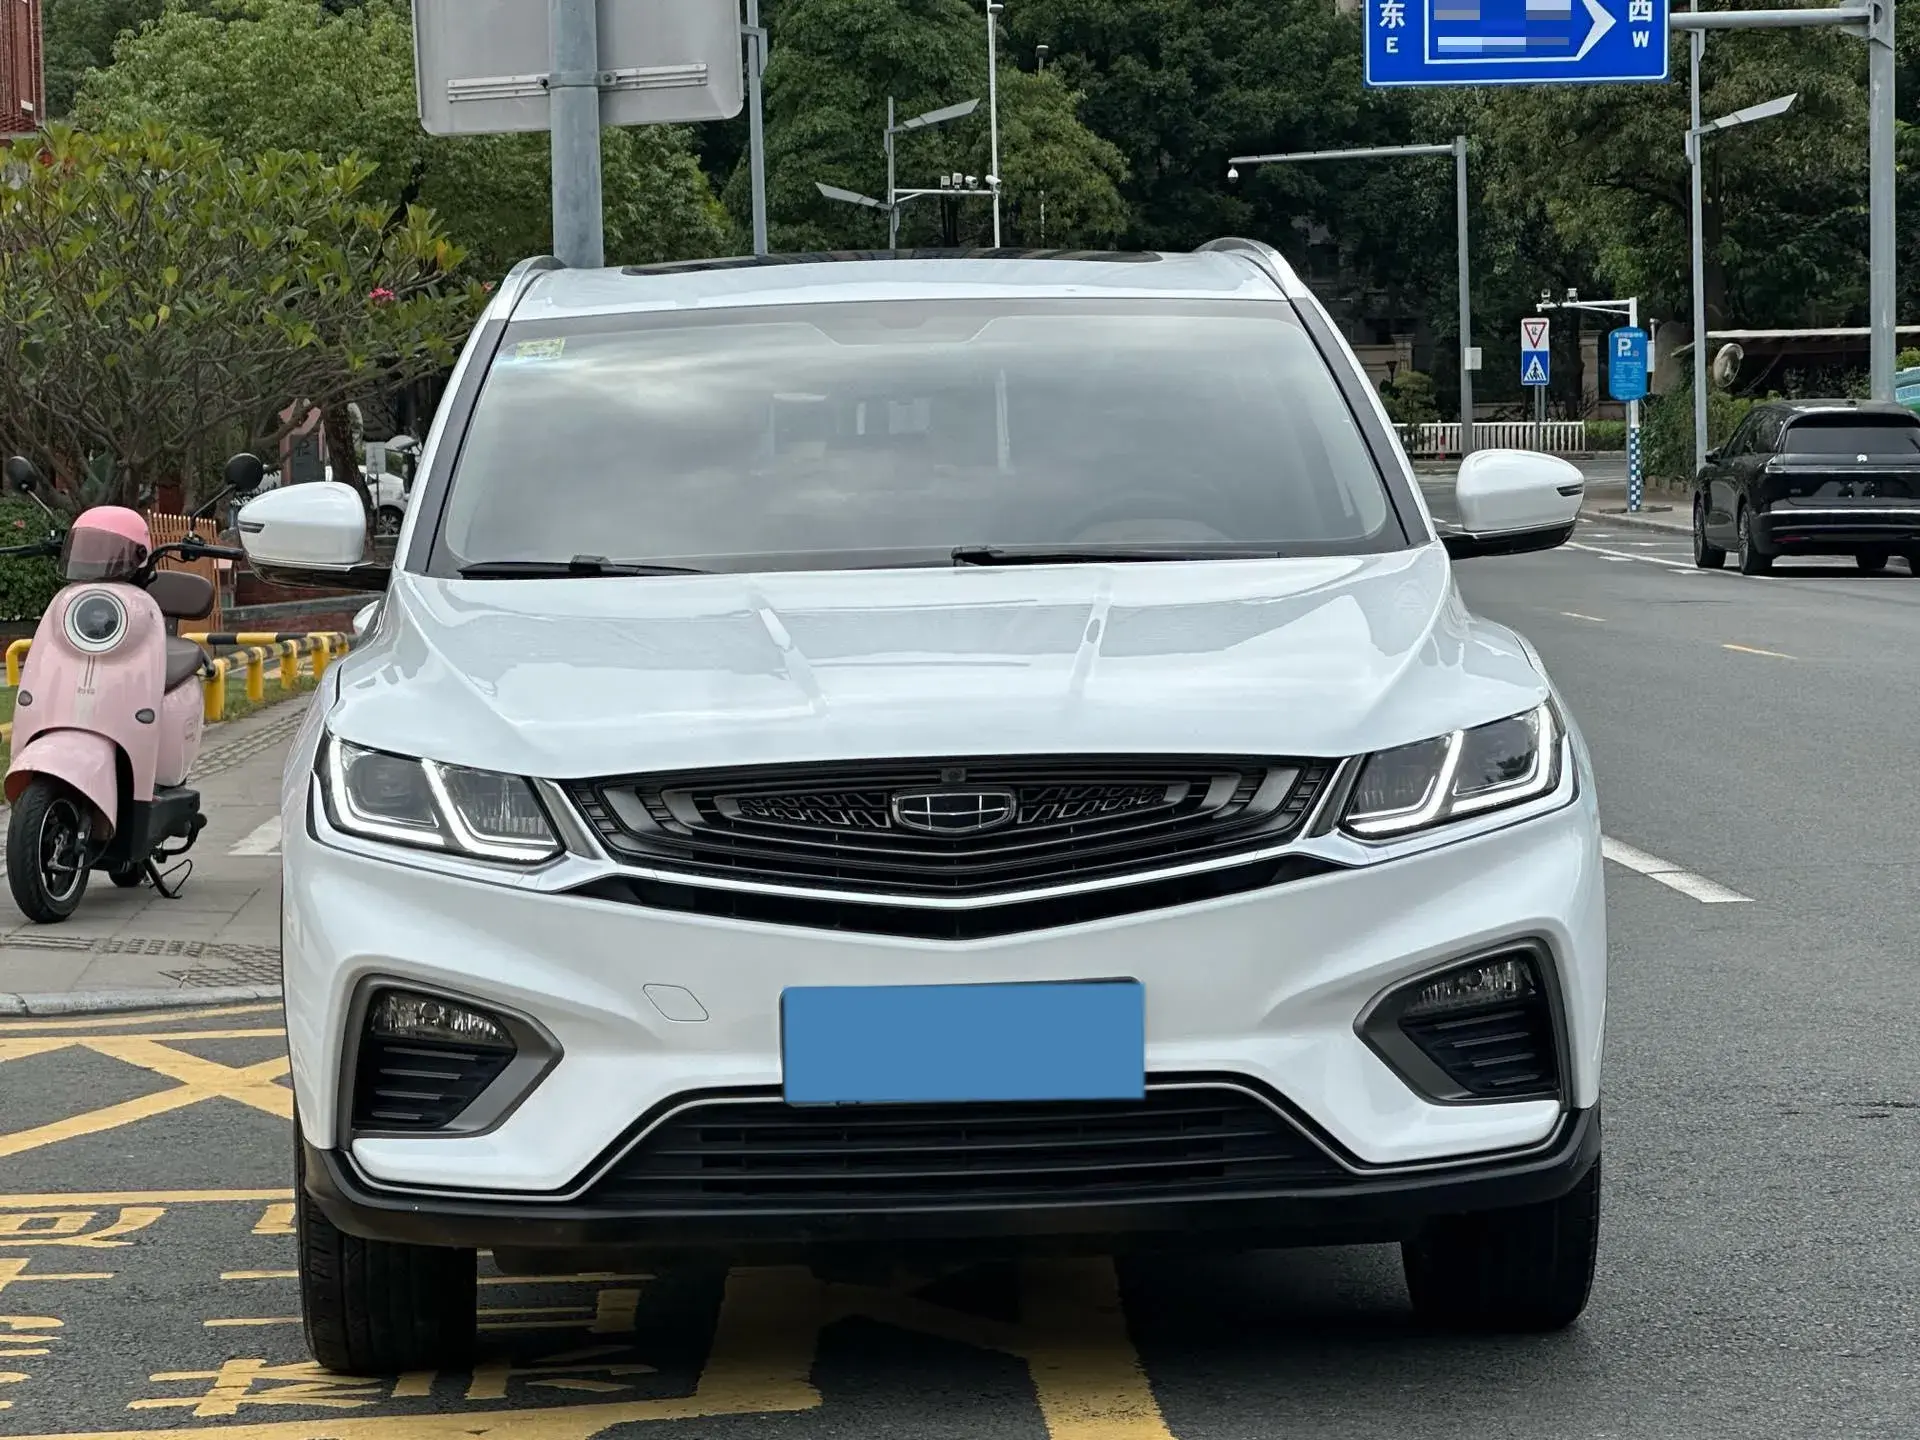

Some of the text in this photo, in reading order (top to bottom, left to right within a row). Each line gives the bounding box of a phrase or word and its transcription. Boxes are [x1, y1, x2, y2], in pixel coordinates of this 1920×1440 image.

[1379, 0, 1405, 29] 东
[1629, 0, 1652, 22] 西
[1386, 36, 1399, 53] E
[1632, 30, 1650, 48] W
[1617, 338, 1632, 357] P
